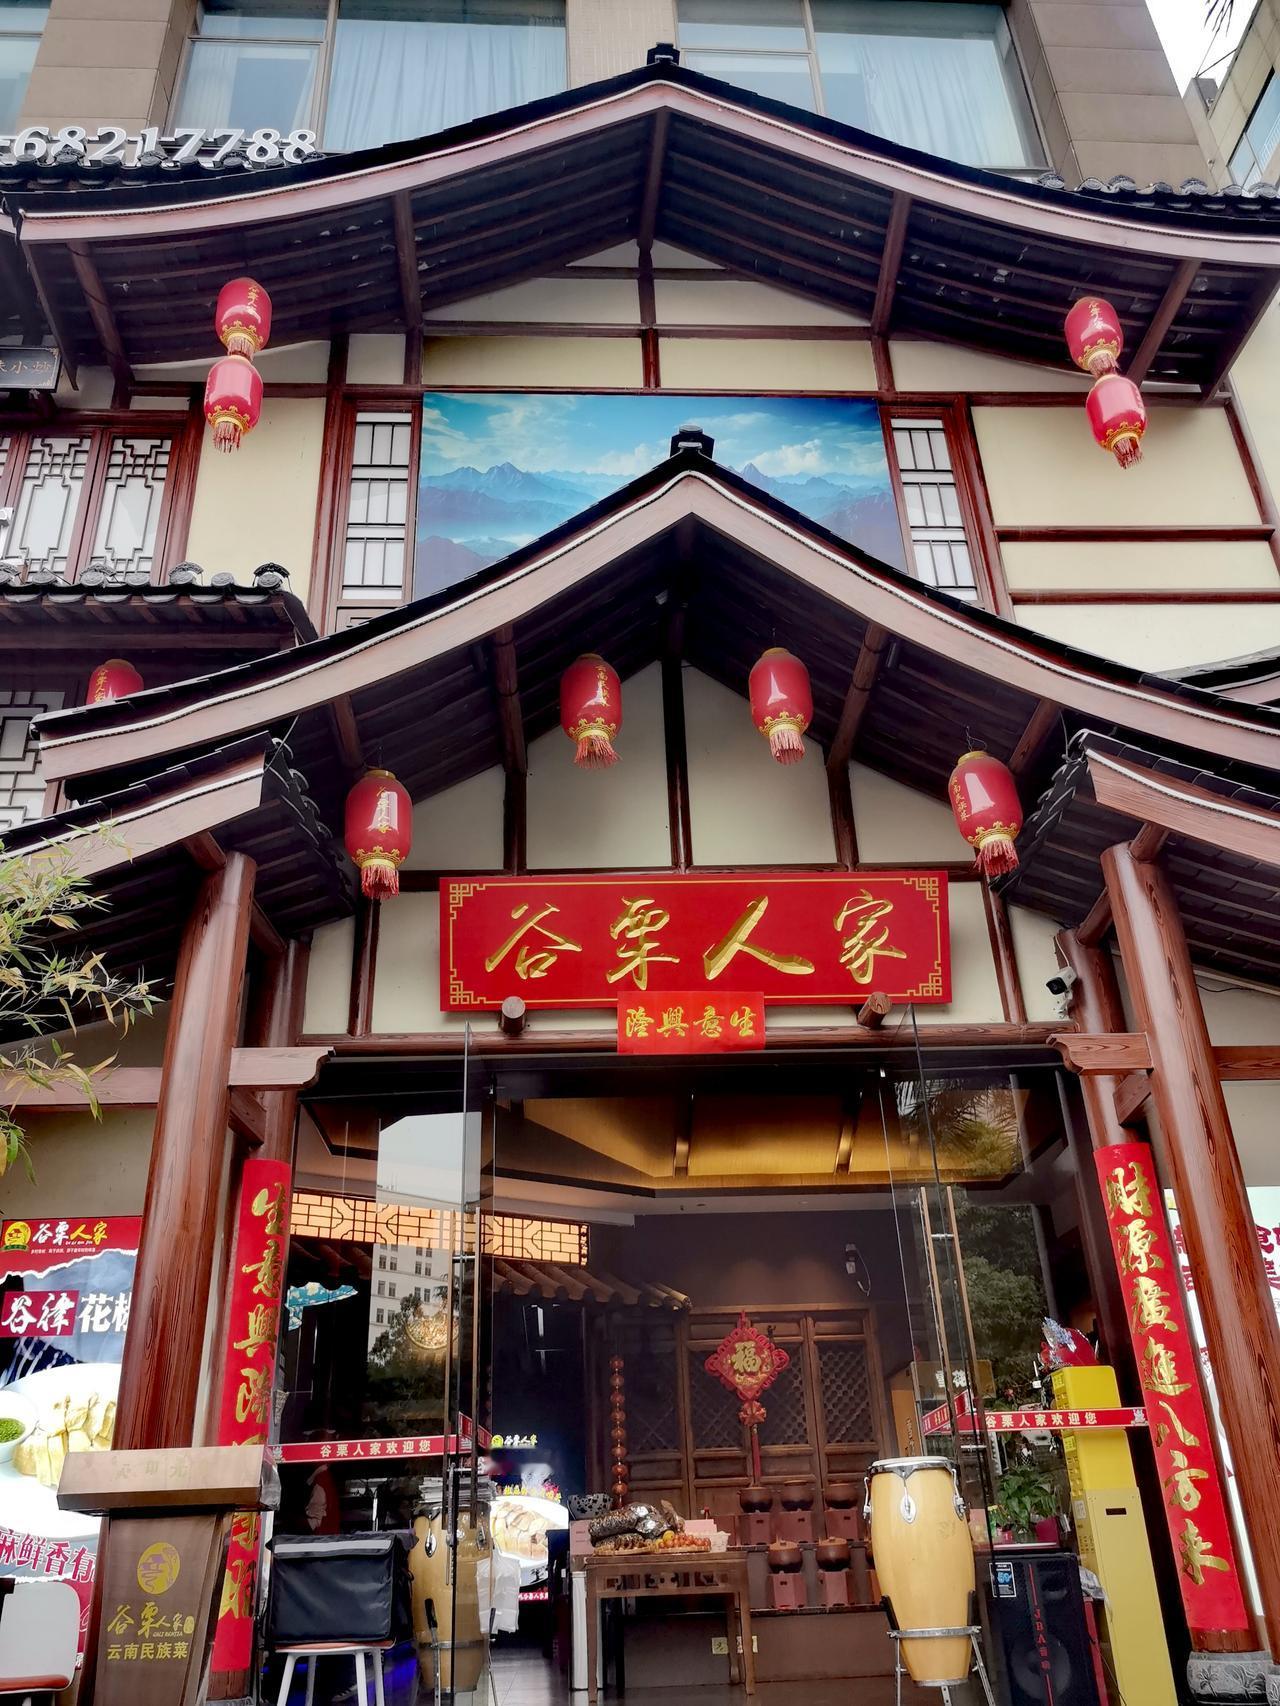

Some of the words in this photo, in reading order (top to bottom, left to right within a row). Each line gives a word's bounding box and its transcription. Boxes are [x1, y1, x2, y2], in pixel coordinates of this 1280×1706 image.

[485, 889, 907, 990] 谷栗人家
[731, 1340, 762, 1373] 福
[107, 1641, 189, 1661] 云南民族菜
